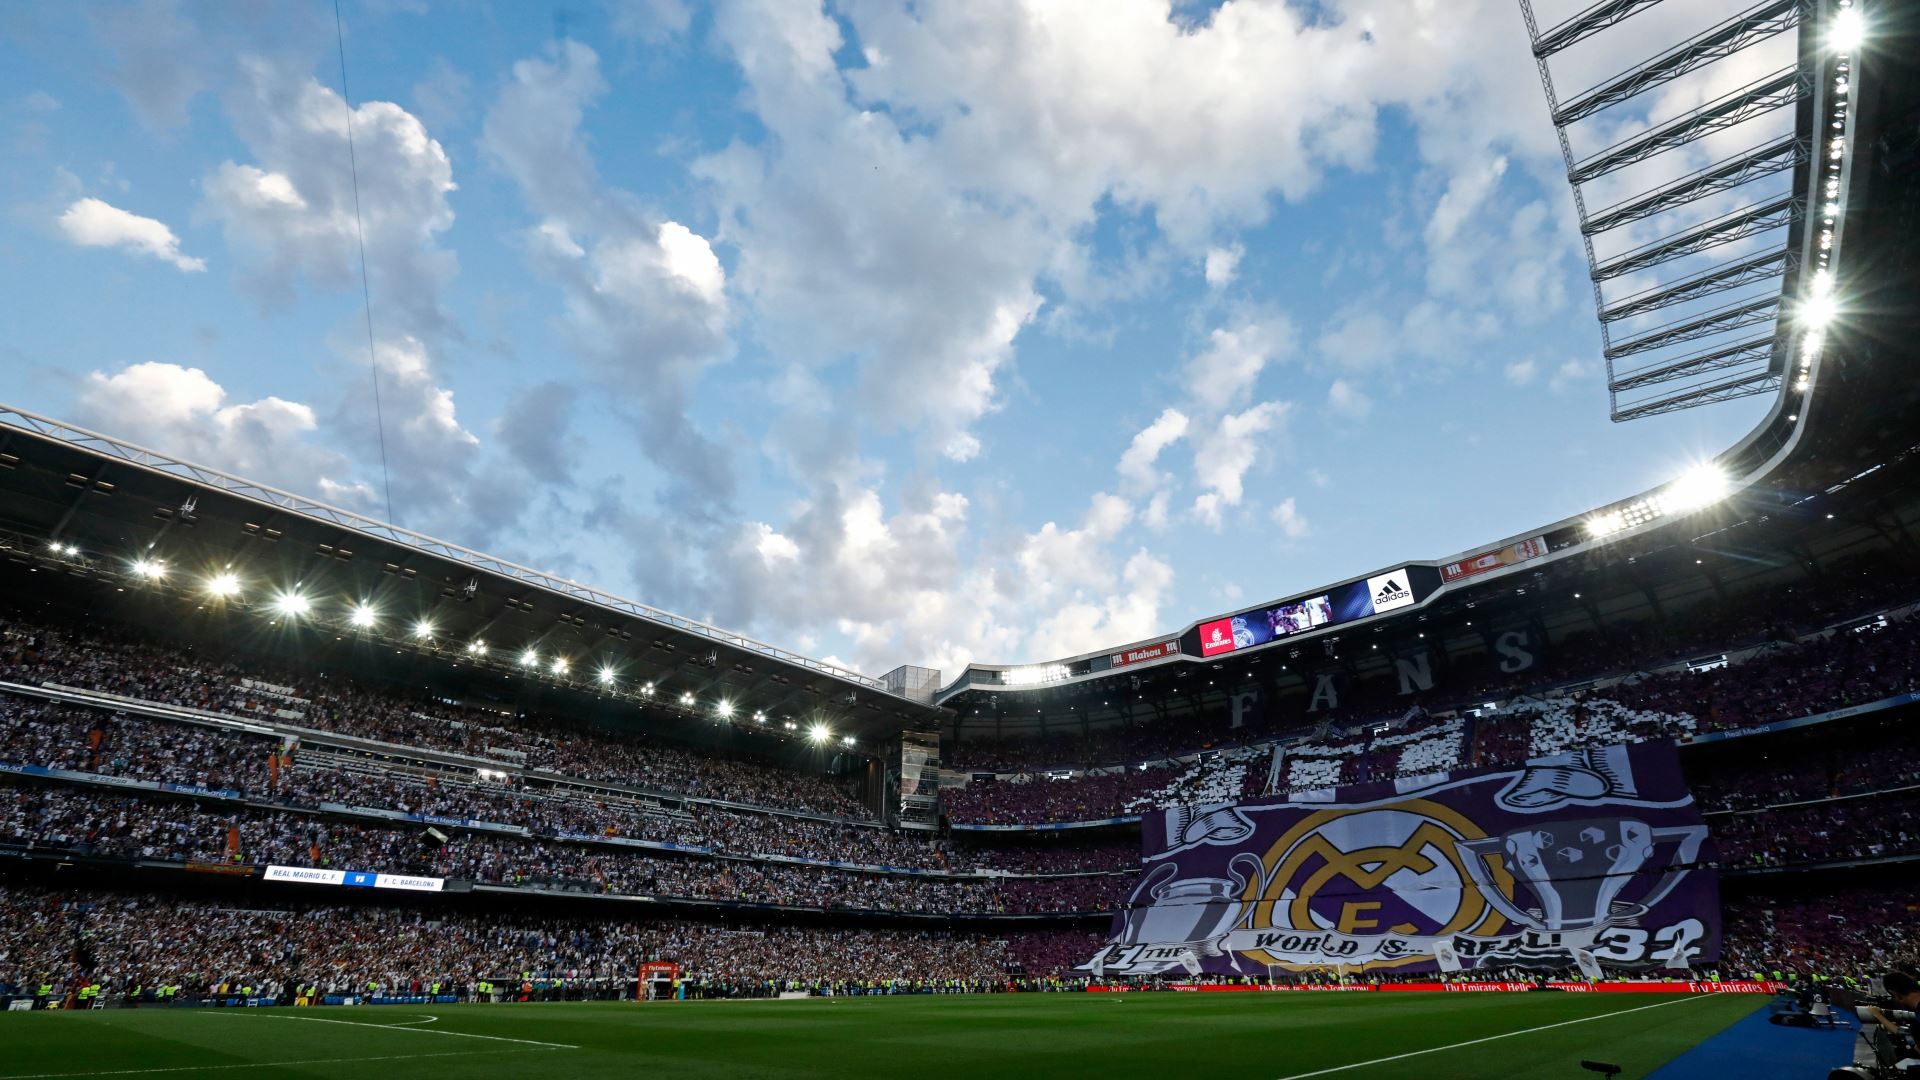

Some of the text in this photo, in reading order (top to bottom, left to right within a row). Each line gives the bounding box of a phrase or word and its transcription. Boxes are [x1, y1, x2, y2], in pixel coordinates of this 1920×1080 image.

[1375, 590, 1410, 605] adidas
[1205, 638, 1231, 649] Emirates
[175, 785, 196, 793] Real
[273, 869, 291, 878] REAL
[292, 871, 321, 880] MADRID
[400, 879, 434, 888] BARCELONA
[1144, 947, 1187, 959] THE
[1255, 932, 1359, 954] WORLD
[1592, 917, 1705, 962] 32
